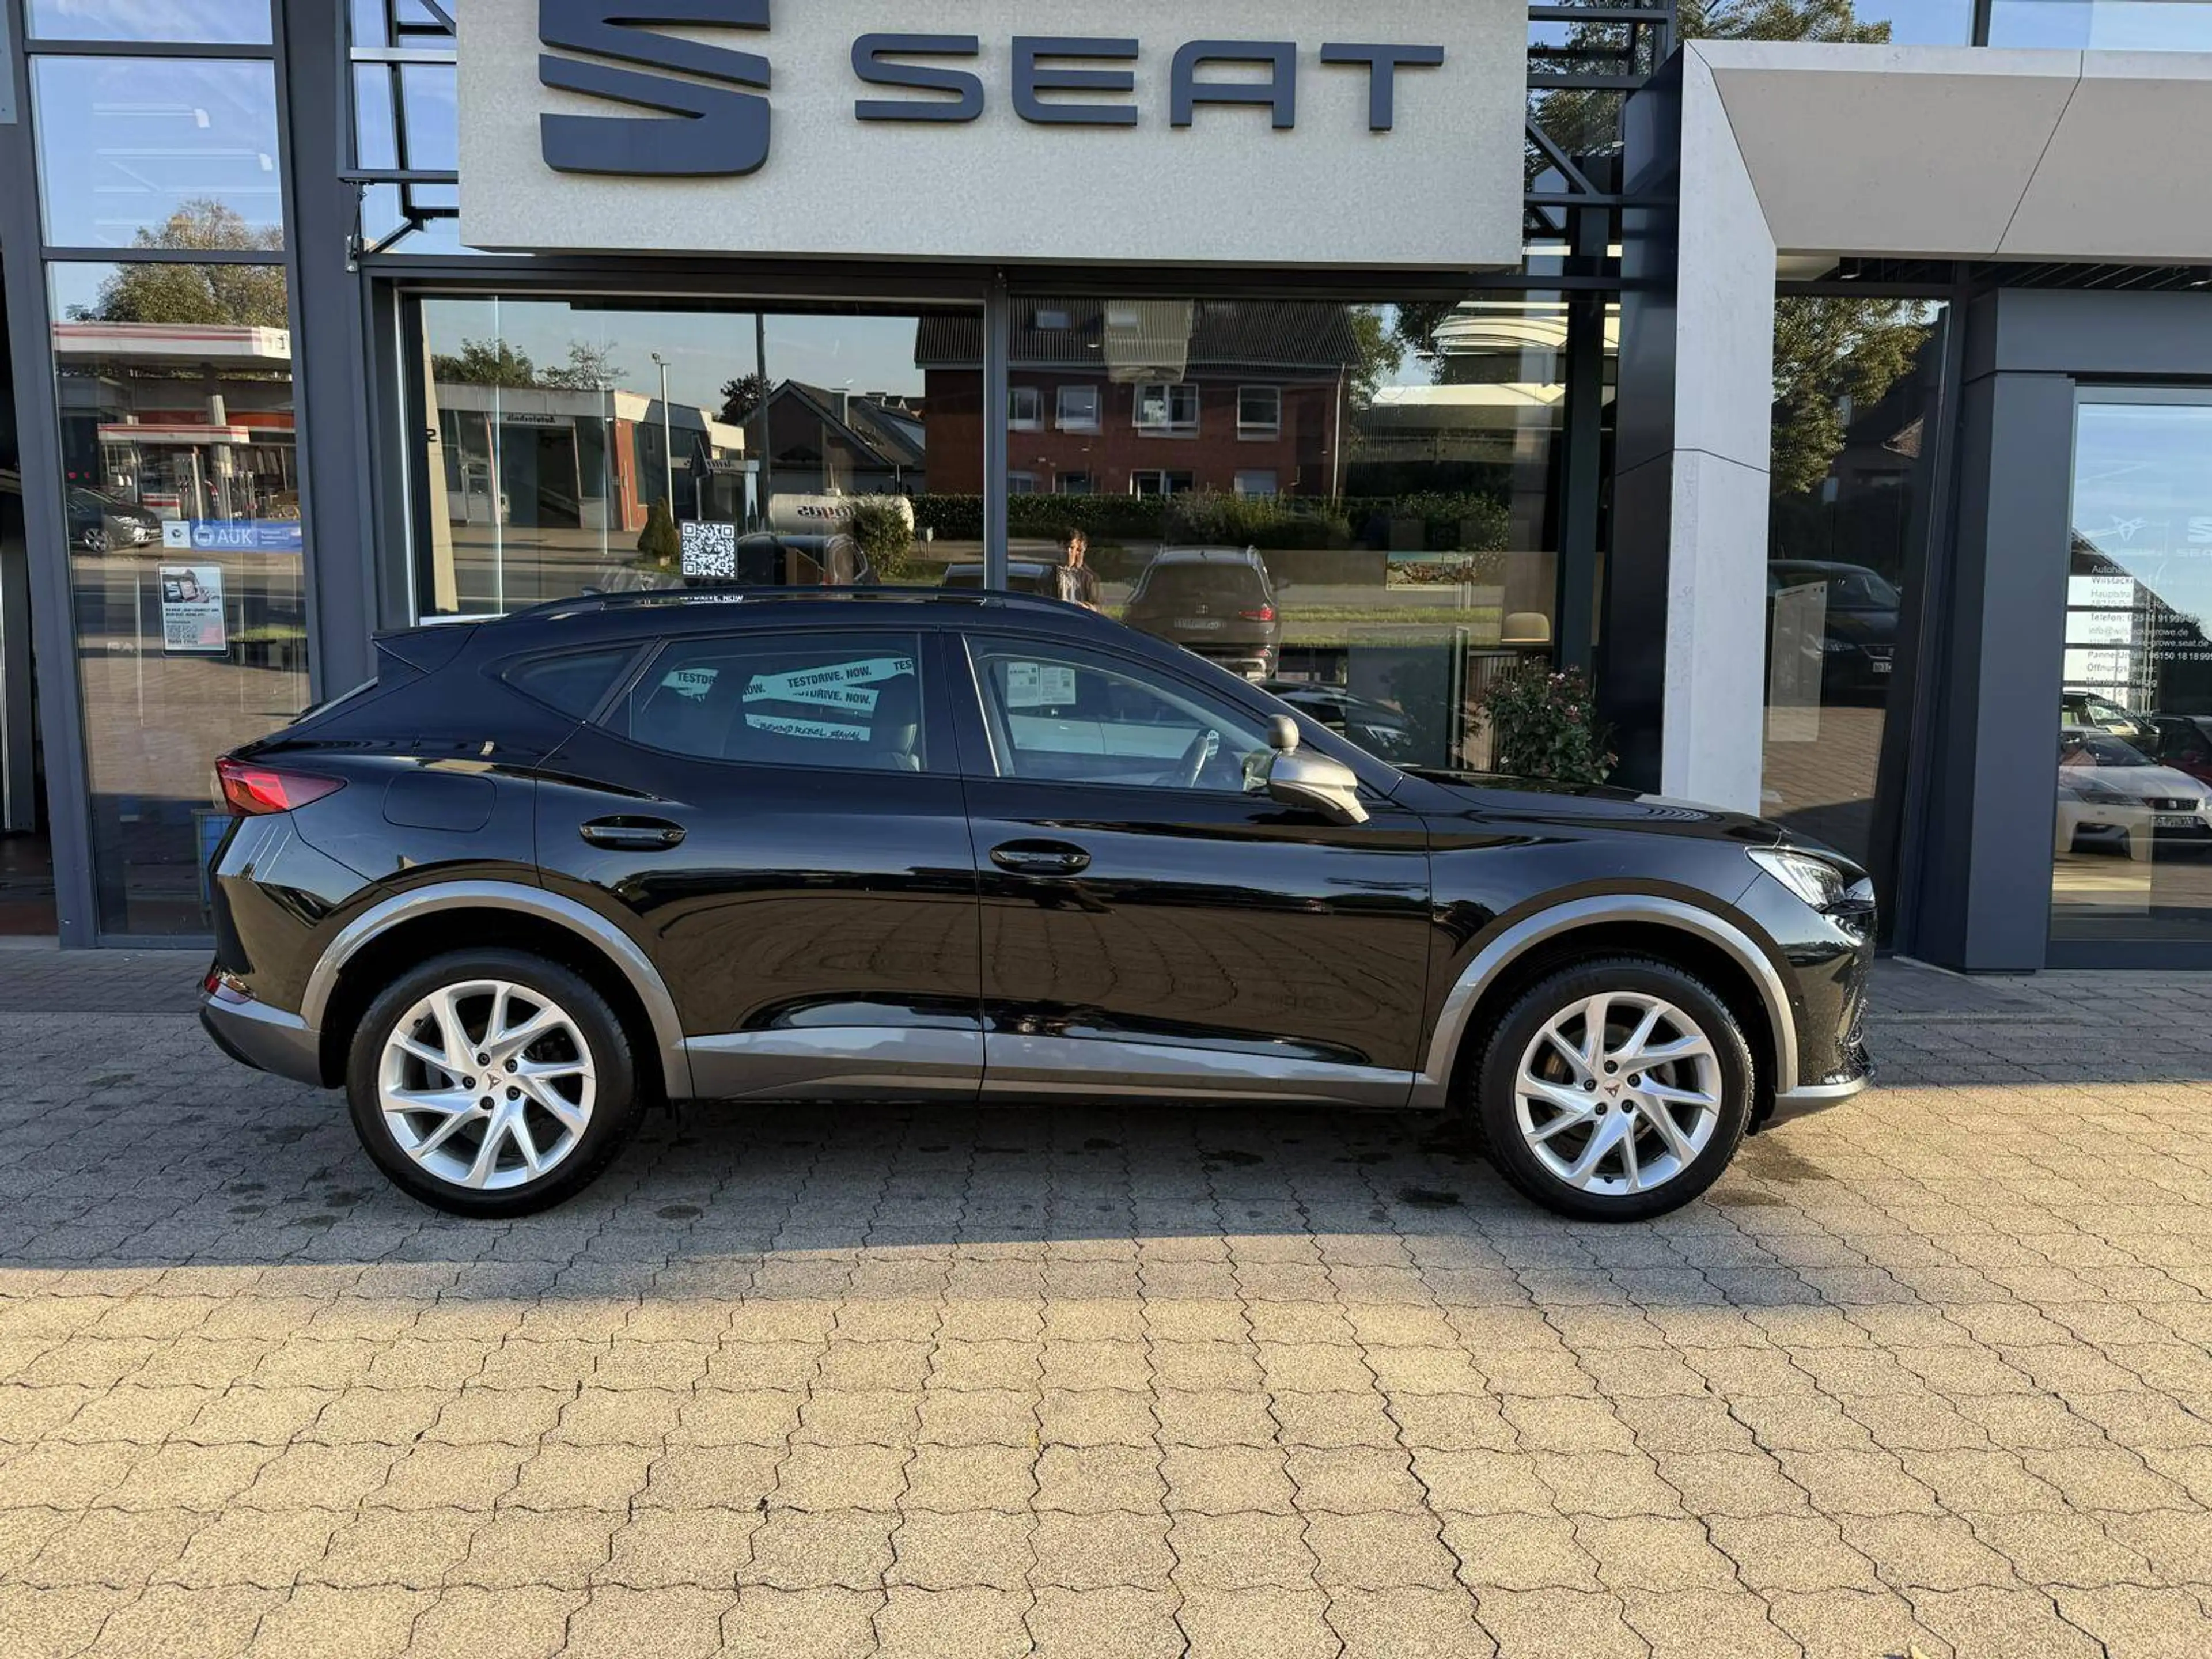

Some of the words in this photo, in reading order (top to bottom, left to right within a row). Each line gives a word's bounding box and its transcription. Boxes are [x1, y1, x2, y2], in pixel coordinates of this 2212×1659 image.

[850, 32, 1444, 136] SEAT
[217, 529, 253, 544] AUK
[787, 670, 844, 688] TESTDRIVE.
[846, 666, 872, 680] NOW.
[845, 692, 871, 705] NOW.
